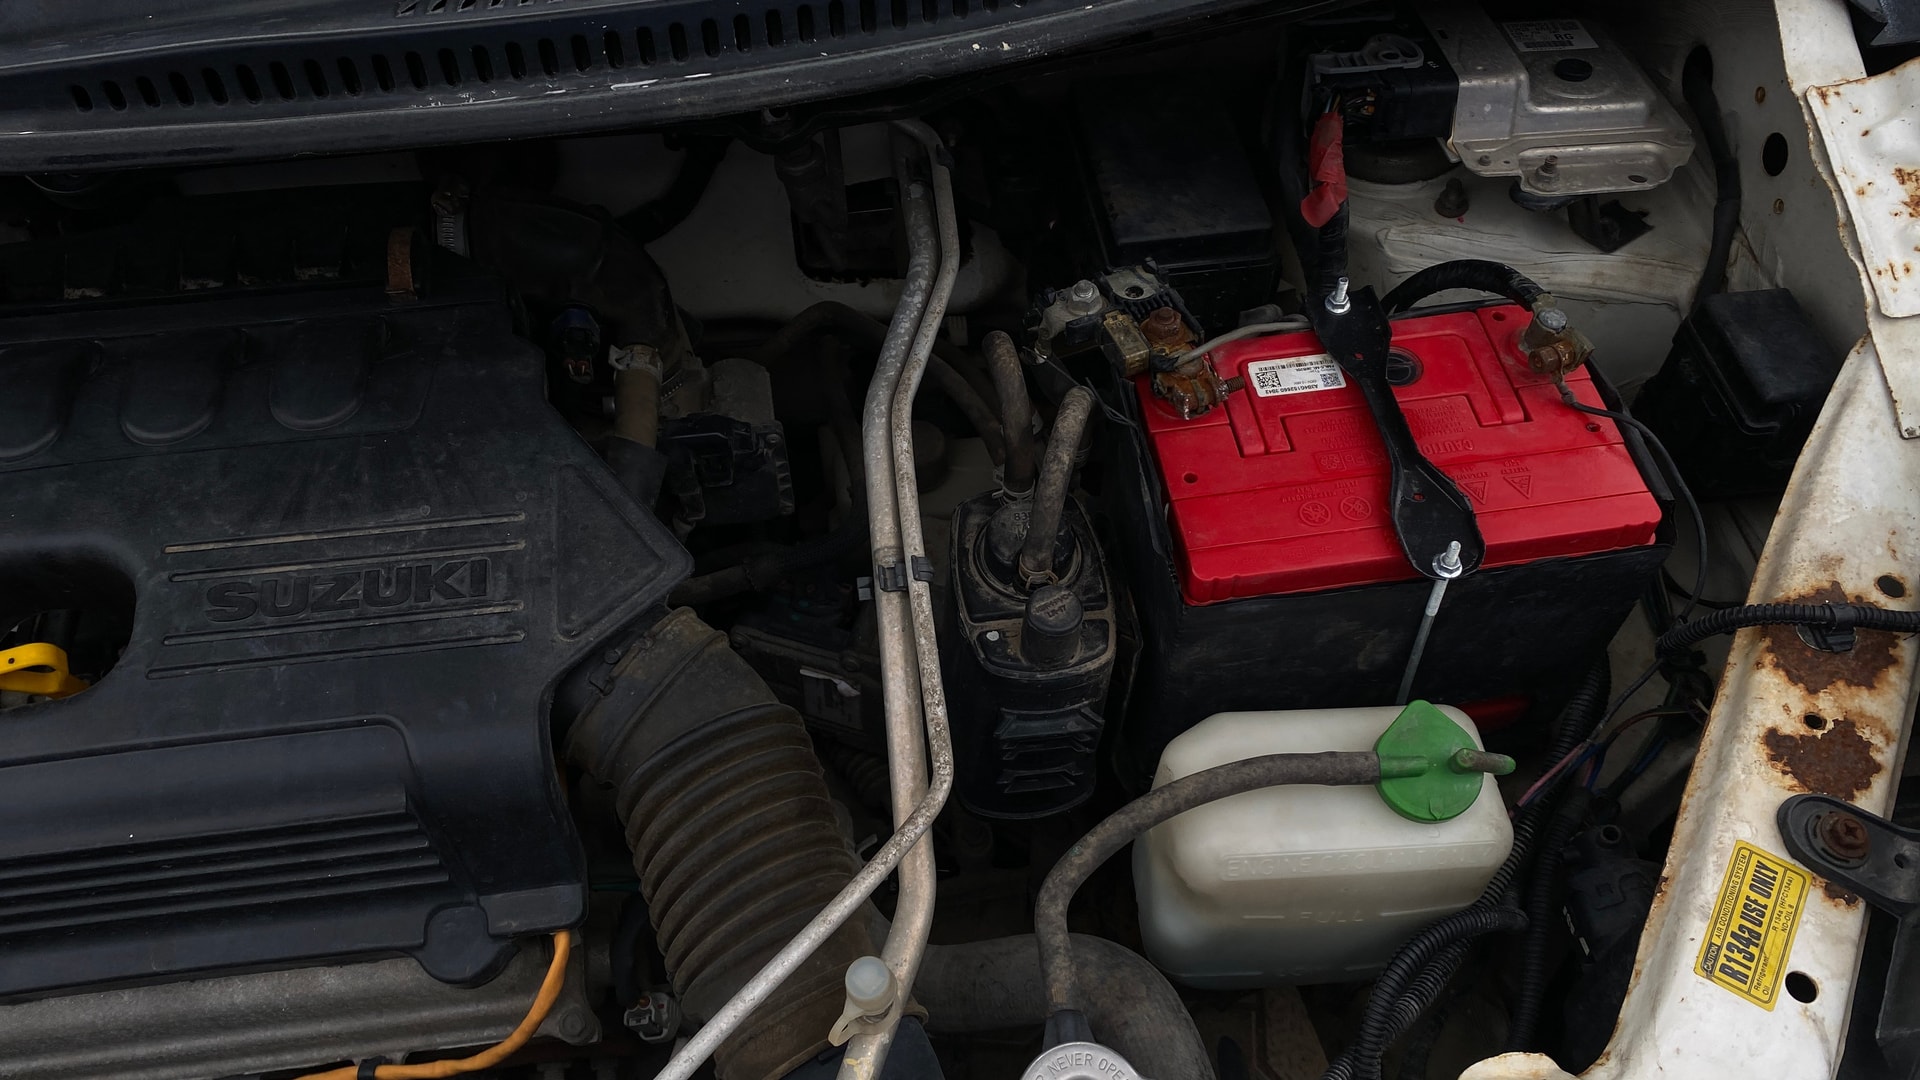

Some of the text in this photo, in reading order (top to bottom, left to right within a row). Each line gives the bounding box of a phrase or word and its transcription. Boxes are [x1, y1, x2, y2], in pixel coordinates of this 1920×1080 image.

[1554, 33, 1574, 41] RG
[1420, 439, 1474, 455] CAUTIO
[206, 558, 491, 622] SUZUKI
[1226, 845, 1497, 878] ENGINE COOLANT ONLY
[1297, 910, 1365, 924] FULL
[1704, 853, 1748, 972] CAUTION AIR CONDITIONING SYSTEM
[1718, 860, 1779, 985] R134a USE ONLY
[1781, 910, 1793, 933] ND-OIL
[1753, 956, 1769, 991] Refrigerant
[1047, 1052, 1130, 1080] NEVER OPE
